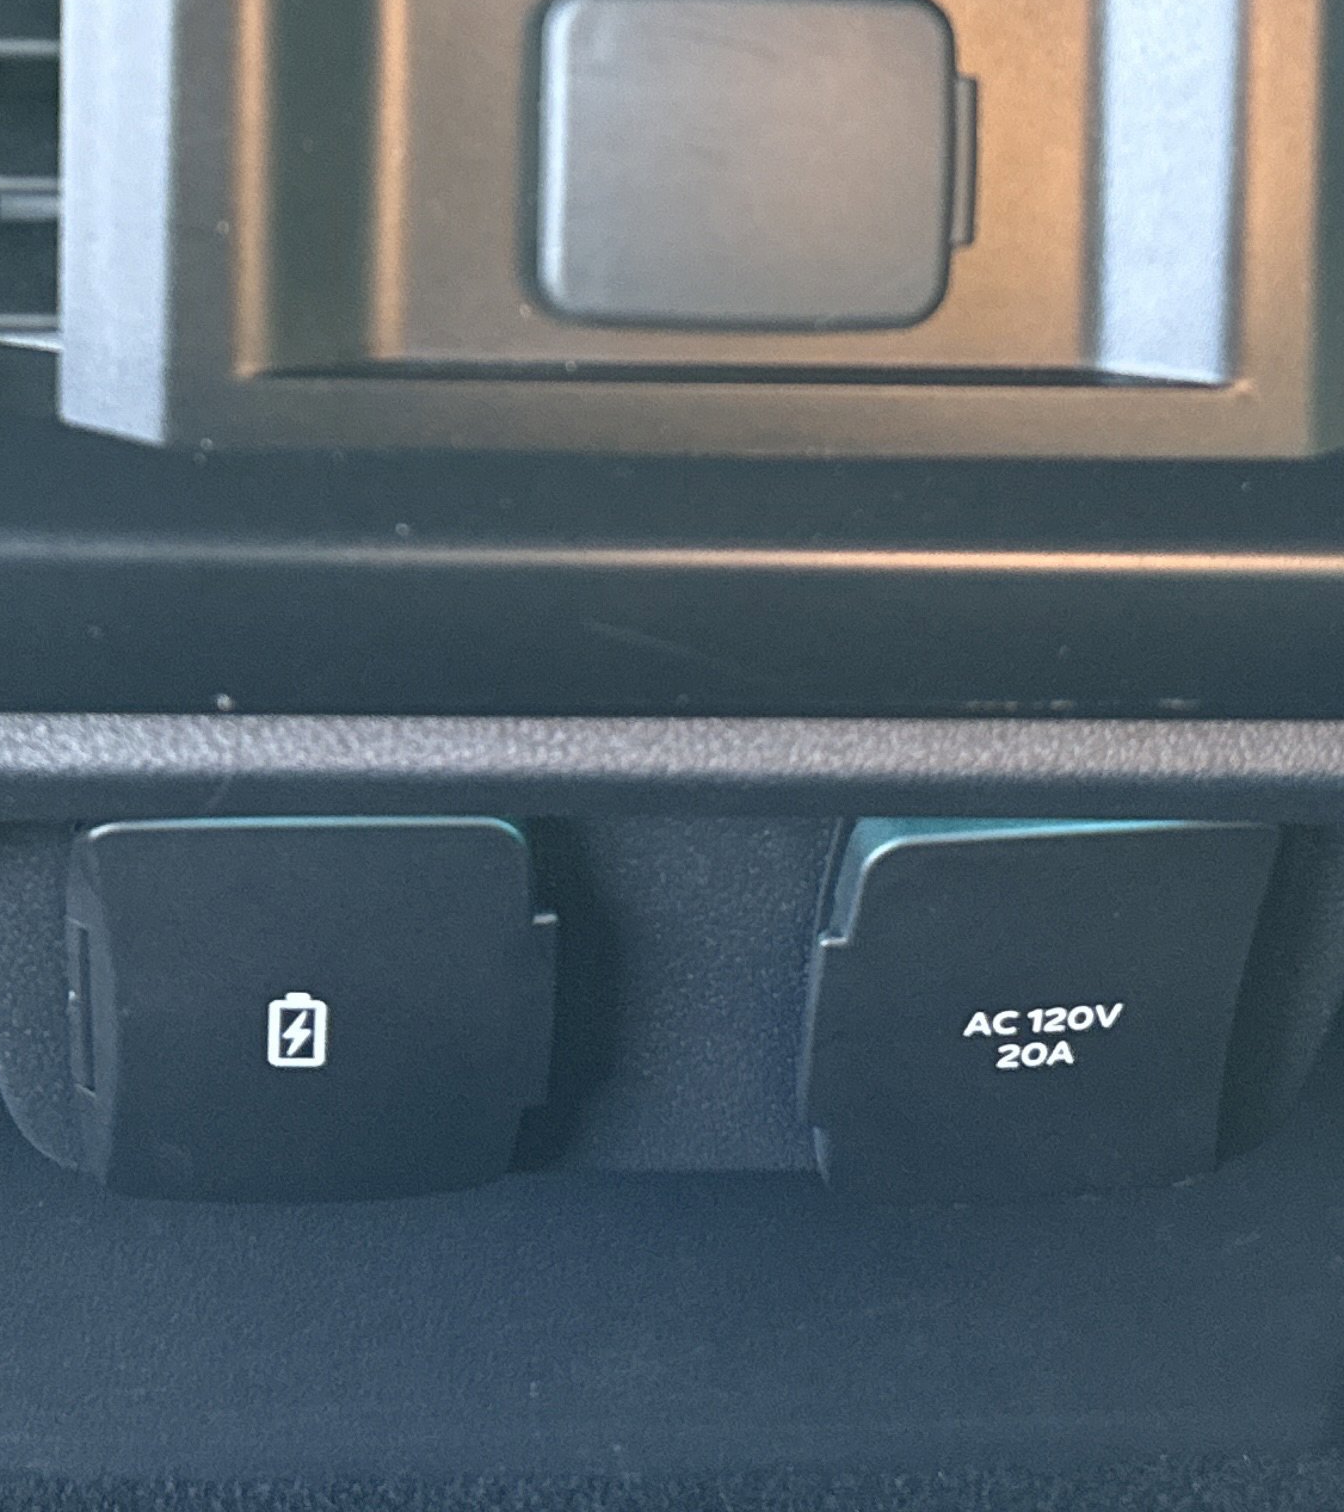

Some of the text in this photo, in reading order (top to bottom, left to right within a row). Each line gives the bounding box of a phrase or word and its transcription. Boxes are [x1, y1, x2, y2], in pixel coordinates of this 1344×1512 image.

[963, 1003, 1124, 1037] AC 120V
[996, 1041, 1074, 1069] 20A
